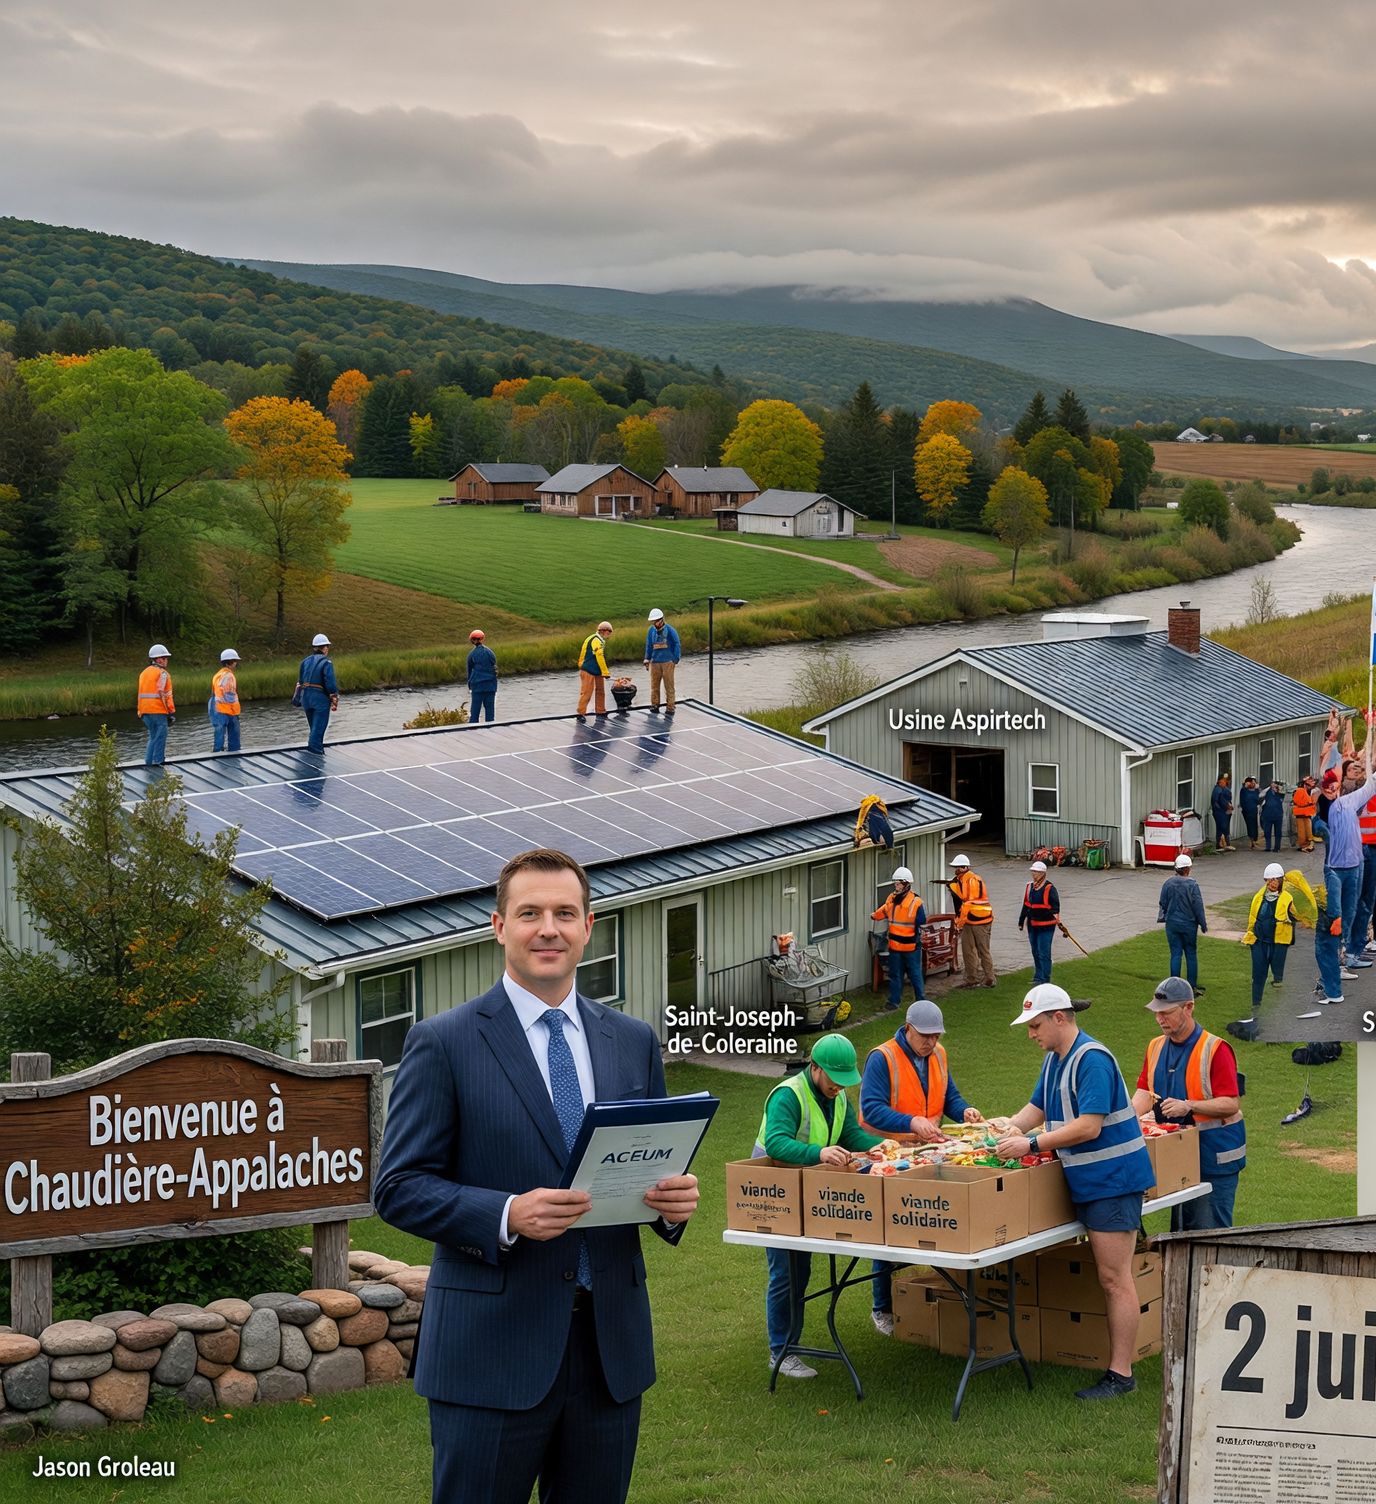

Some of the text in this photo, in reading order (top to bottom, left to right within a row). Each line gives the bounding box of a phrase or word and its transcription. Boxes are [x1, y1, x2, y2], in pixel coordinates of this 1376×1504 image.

[89, 1083, 284, 1146] Bienvenue à
[600, 1147, 674, 1164] ACEUM
[4, 1135, 364, 1215] Chaudière-Appalaches
[740, 1181, 786, 1199] viande
[818, 1186, 865, 1204] viande
[901, 1193, 950, 1211] viande
[811, 1203, 873, 1222] solidaire
[892, 1210, 958, 1230] solidaire
[1220, 1301, 1267, 1394] 2
